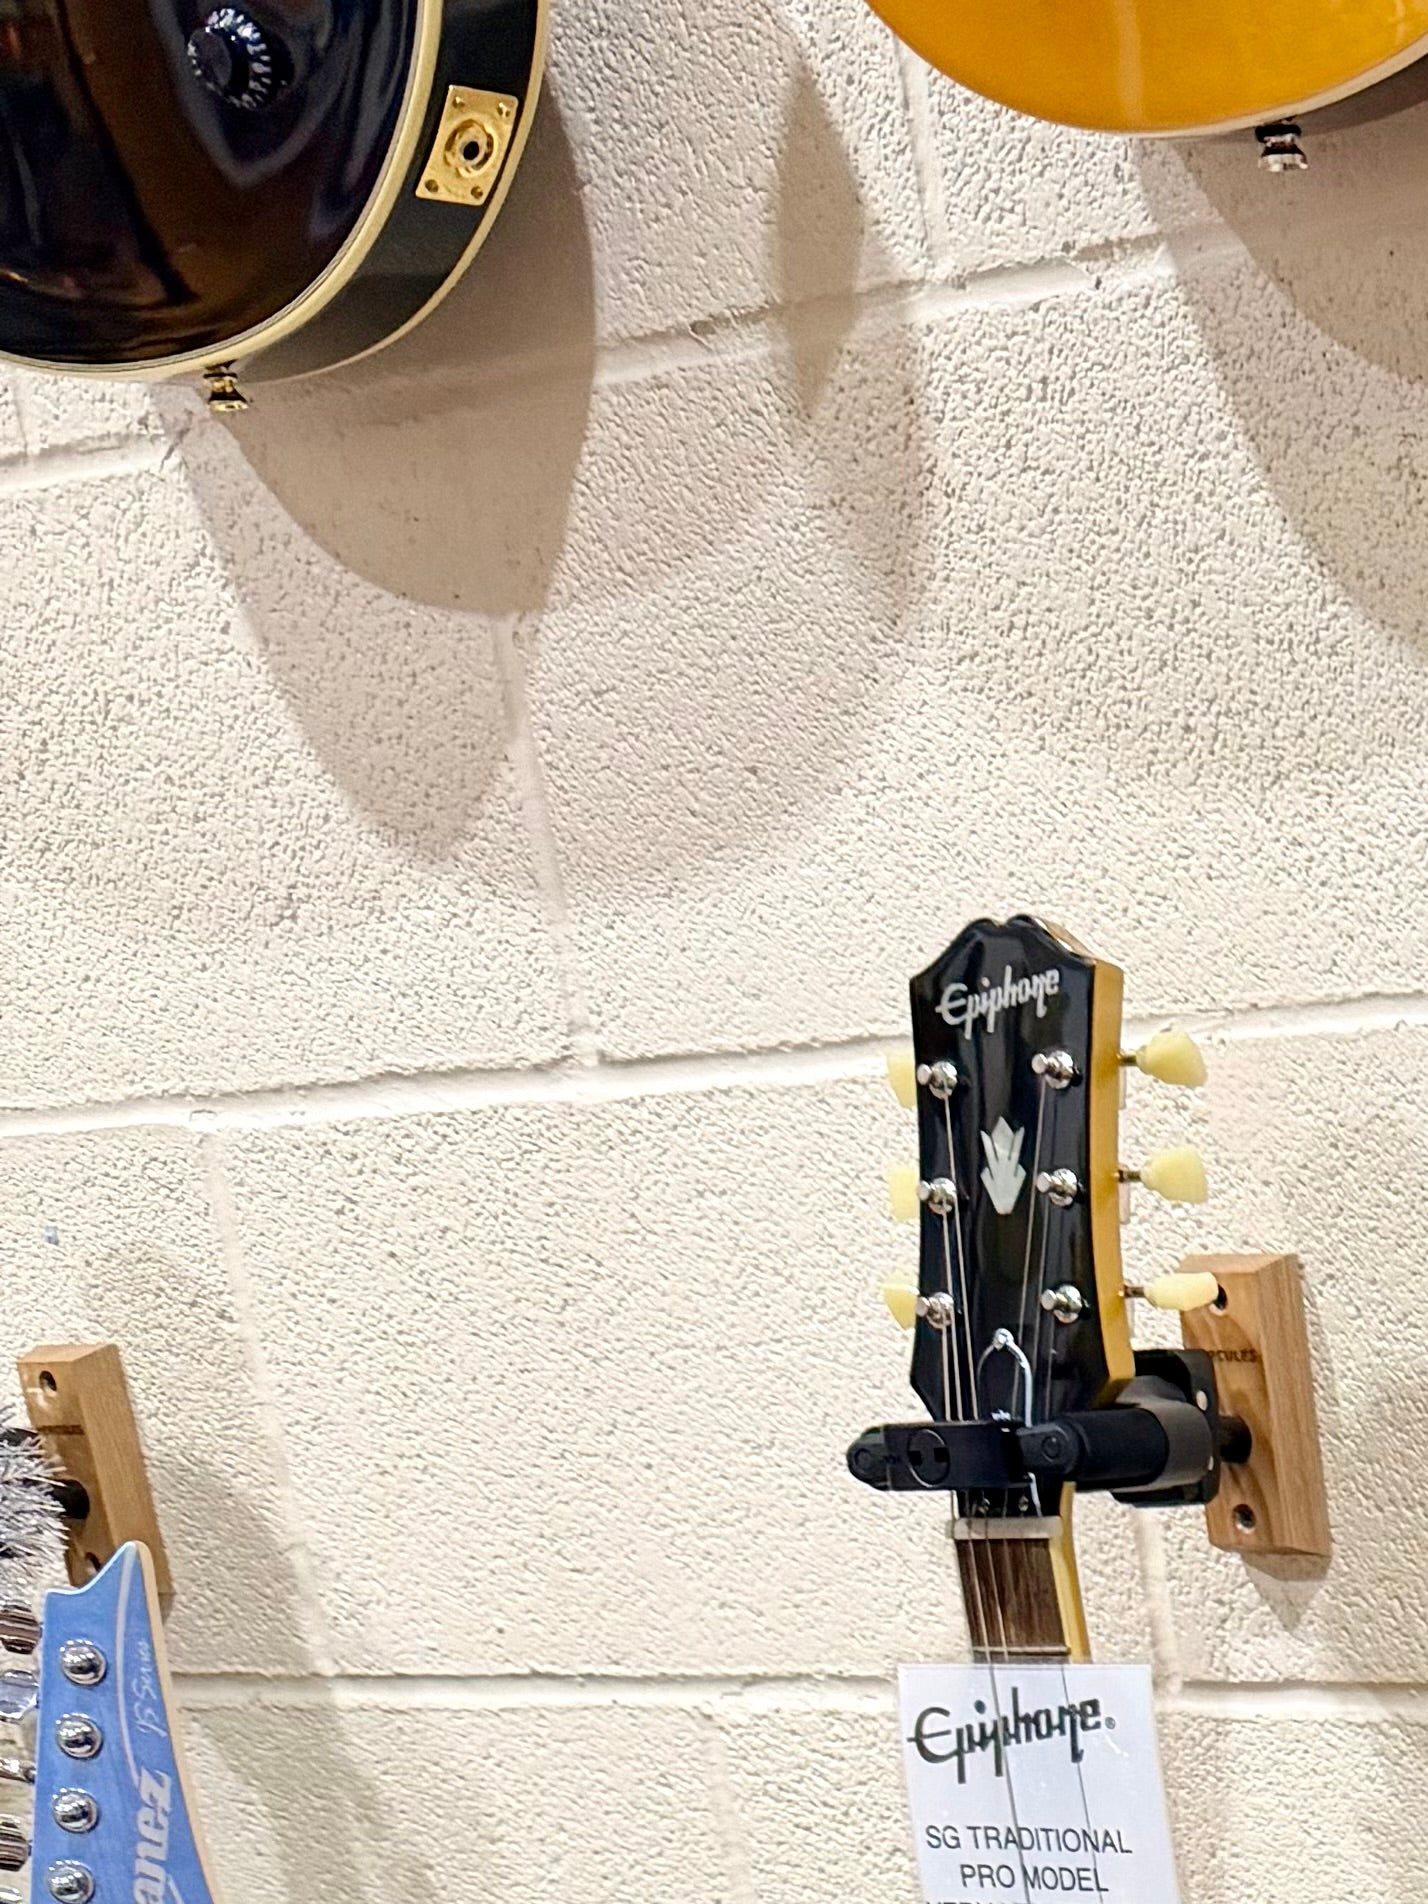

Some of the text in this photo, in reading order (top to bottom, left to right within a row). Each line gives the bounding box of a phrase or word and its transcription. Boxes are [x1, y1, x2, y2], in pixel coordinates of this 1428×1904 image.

[935, 965, 1060, 1039] Epiphone
[925, 1825, 1133, 1855] SG TRADITIONAL
[960, 1864, 1109, 1893] PRO MODEL
